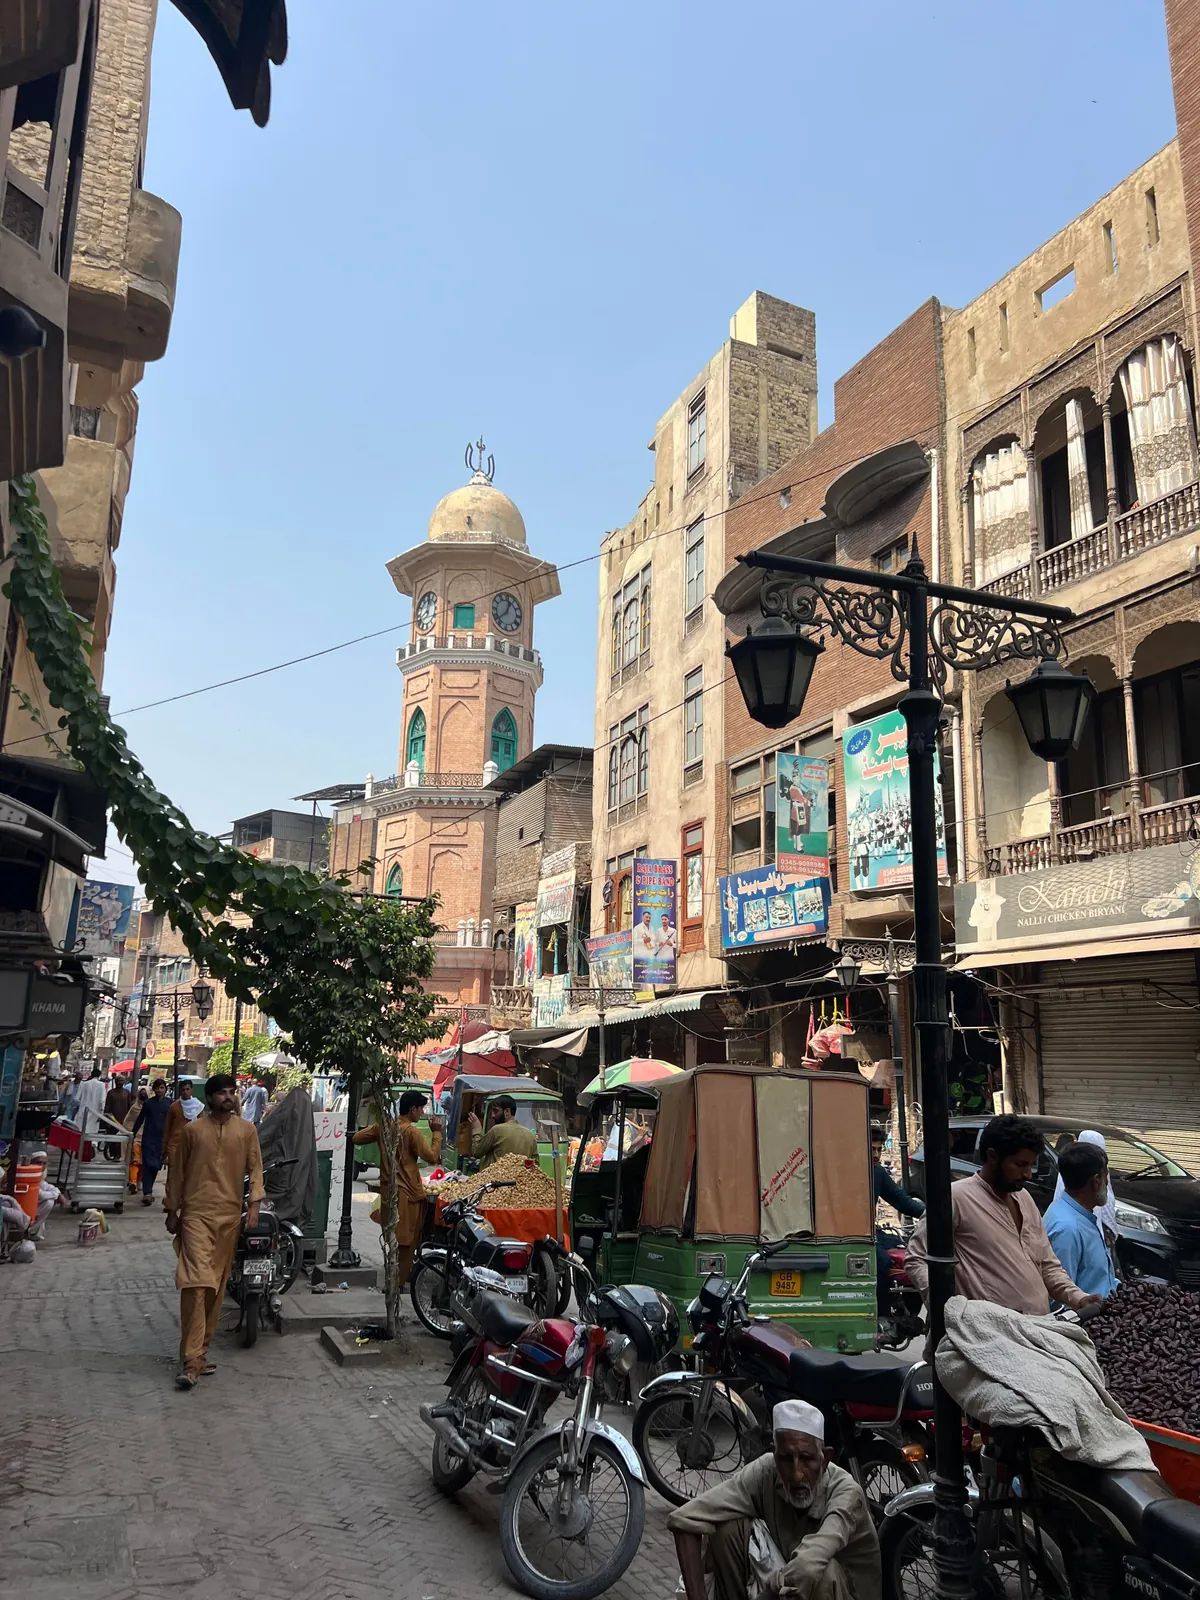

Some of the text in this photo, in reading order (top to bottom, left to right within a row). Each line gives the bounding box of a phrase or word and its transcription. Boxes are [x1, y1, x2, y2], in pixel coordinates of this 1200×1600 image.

[654, 864, 672, 874] BRASS
[642, 876, 656, 885] PIPE
[658, 877, 674, 886] BAND
[1018, 868, 1127, 912] Karachi
[1048, 911, 1087, 924] CHICKEN
[1088, 904, 1126, 918] BIRYANI
[32, 1002, 66, 1014] KHANA
[780, 1272, 792, 1280] GB
[776, 1281, 796, 1290] 9487
